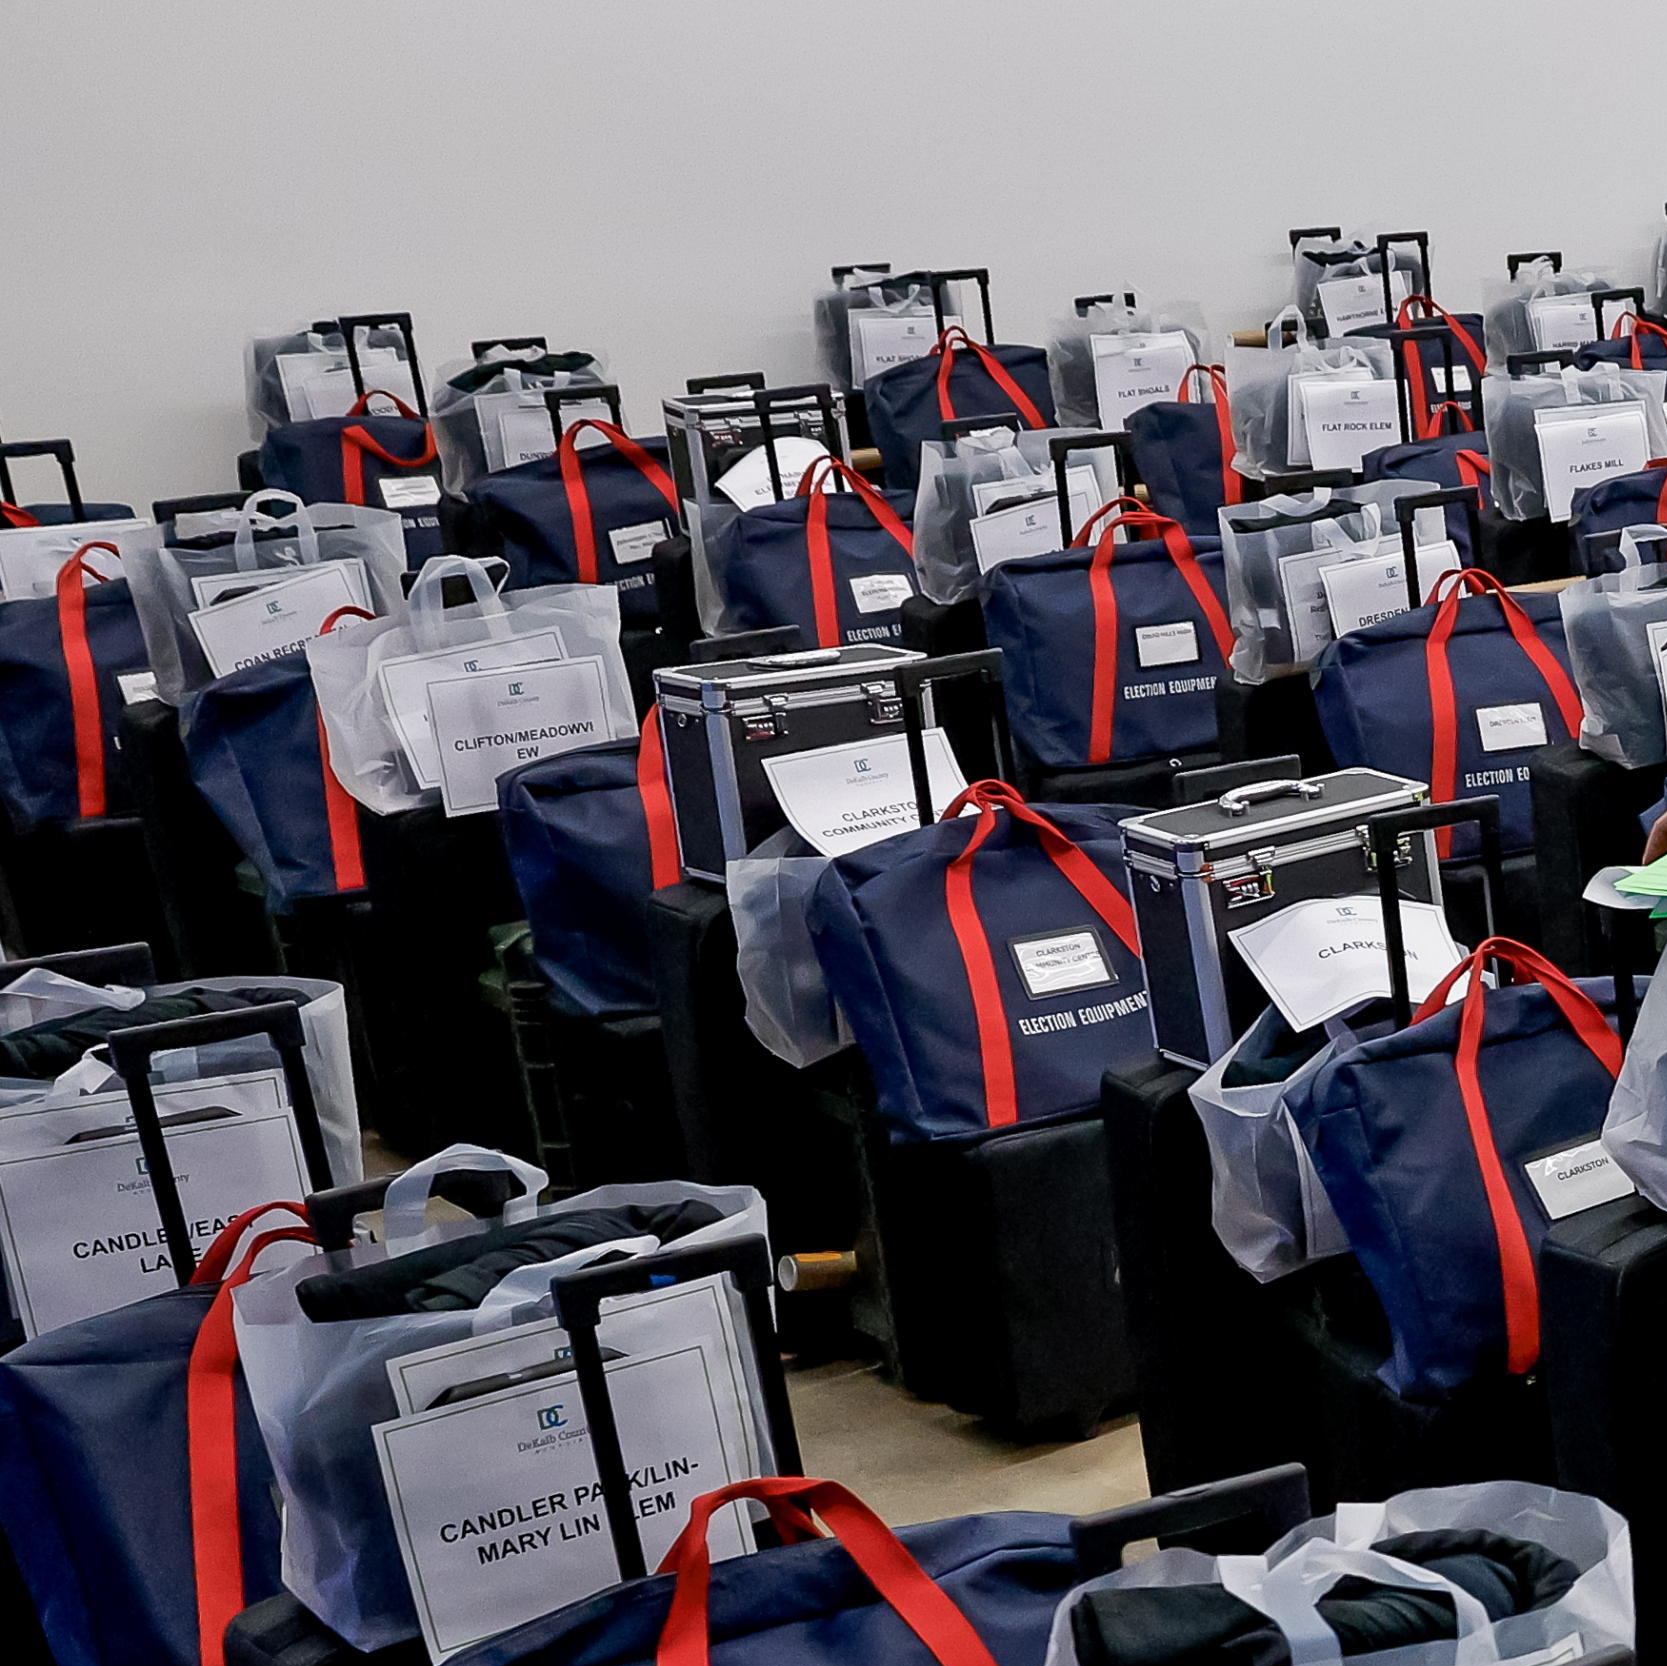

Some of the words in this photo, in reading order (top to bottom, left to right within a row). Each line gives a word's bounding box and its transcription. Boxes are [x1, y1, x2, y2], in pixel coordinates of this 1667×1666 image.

[1322, 424, 1342, 433] FLAT
[1345, 423, 1367, 432] ROCK
[1370, 421, 1392, 431] ELEM
[1570, 462, 1602, 474] FLAKES
[1605, 458, 1624, 469] MILL
[1359, 607, 1411, 628] DRESDEN
[846, 626, 889, 642] ELECTION
[234, 654, 269, 671] COAN
[1124, 682, 1166, 700] ELECTION
[1169, 676, 1217, 695] EQUIPME
[454, 721, 595, 752] CLIFTON/MEADOWVI
[516, 745, 540, 760] EW
[1465, 769, 1513, 788] ELECTION
[841, 800, 919, 822] CLARKSTO
[822, 811, 901, 838] COMMUNITY
[1317, 938, 1420, 962] CLARKSN
[1019, 1008, 1076, 1036] ELECTION
[1557, 1157, 1609, 1181] CLARKSTON
[72, 1213, 255, 1261] CANDLE/EAS
[140, 1243, 204, 1276] LAE
[517, 1433, 557, 1454] DeKalb
[439, 1495, 569, 1546] CANDLER
[573, 1459, 700, 1512] PAK/LIN-
[477, 1530, 553, 1567] MARY
[559, 1517, 601, 1544] LIN
